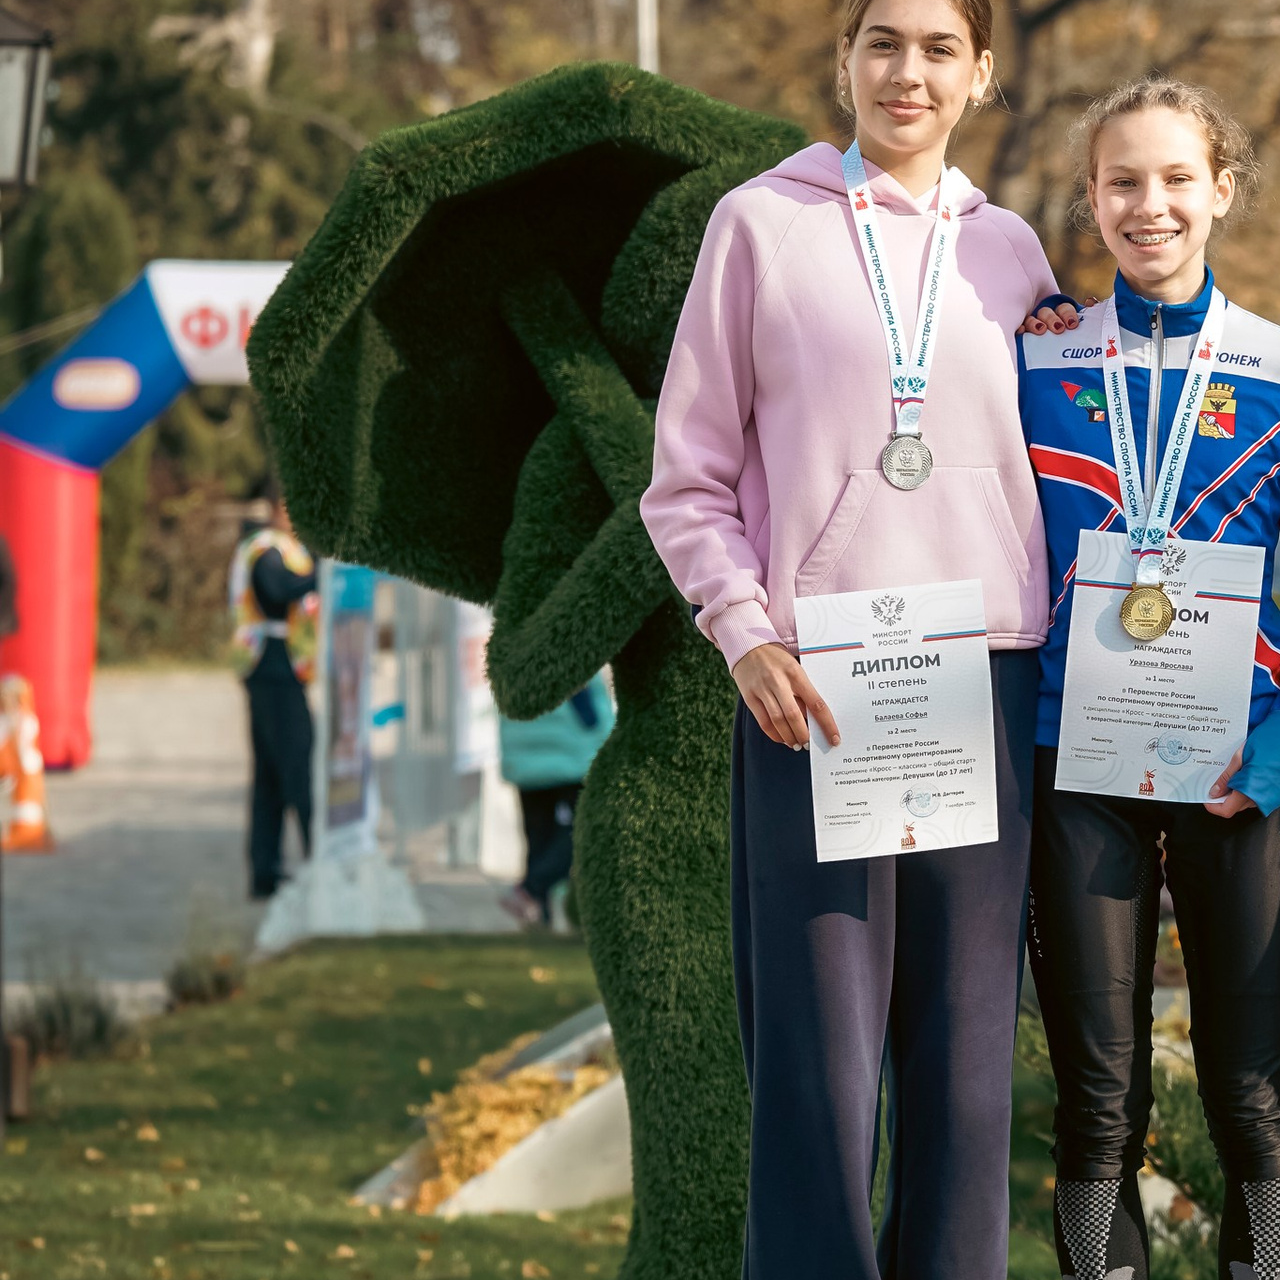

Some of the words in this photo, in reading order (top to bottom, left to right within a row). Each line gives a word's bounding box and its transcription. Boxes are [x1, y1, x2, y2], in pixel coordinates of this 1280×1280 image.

[864, 224, 886, 291] МИНИСТЕРСТВО
[881, 292, 894, 325] СПОРТА
[890, 328, 902, 366] РОССИИ
[917, 303, 934, 367] МИНИСТЕРСТВО
[929, 271, 939, 301] СПОРТА
[935, 234, 946, 268] РОССИИ
[1062, 347, 1102, 359] СШОР
[1110, 371, 1125, 440] МИНИСТЕРСТВО
[1120, 441, 1131, 477] СПОРТА
[1126, 479, 1139, 517] РОССИИ
[1157, 448, 1181, 518] МИНИСТЕРСТВО
[1176, 412, 1191, 446] СПОРТА
[1187, 373, 1202, 410] РОССИИ
[872, 629, 911, 639] МИНСПОРТ
[877, 637, 908, 647] РОССИИ
[1133, 644, 1191, 655] НАГРАЖДАЕТСЯ
[850, 652, 940, 677] ДИПЛОМ
[1128, 658, 1158, 668] Уразова
[1160, 662, 1193, 671] Ярослава
[878, 675, 927, 689] степень
[1127, 687, 1169, 697] Первенстве
[1170, 691, 1195, 699] России
[871, 694, 928, 707] НАГРАЖДАЕТСЯ
[1107, 696, 1154, 706] спортивному
[1156, 701, 1218, 712] ориентированию
[874, 712, 903, 722] Балаева
[905, 709, 928, 720] Софья
[1150, 711, 1179, 719] классика
[1186, 714, 1209, 722] общий
[1090, 716, 1122, 724] возрастной
[1153, 721, 1187, 730] Девушки
[1187, 724, 1200, 732] (до
[1211, 726, 1226, 734] лет)
[871, 740, 913, 752] Первенстве
[914, 738, 939, 747] России
[853, 752, 900, 764] спортивному
[901, 746, 963, 760] ориентированию
[898, 761, 926, 770] классика
[933, 758, 955, 767] общий
[839, 777, 870, 786] возрастной
[902, 770, 934, 781] Девушки
[936, 769, 948, 777] (до
[958, 766, 973, 775] лет)
